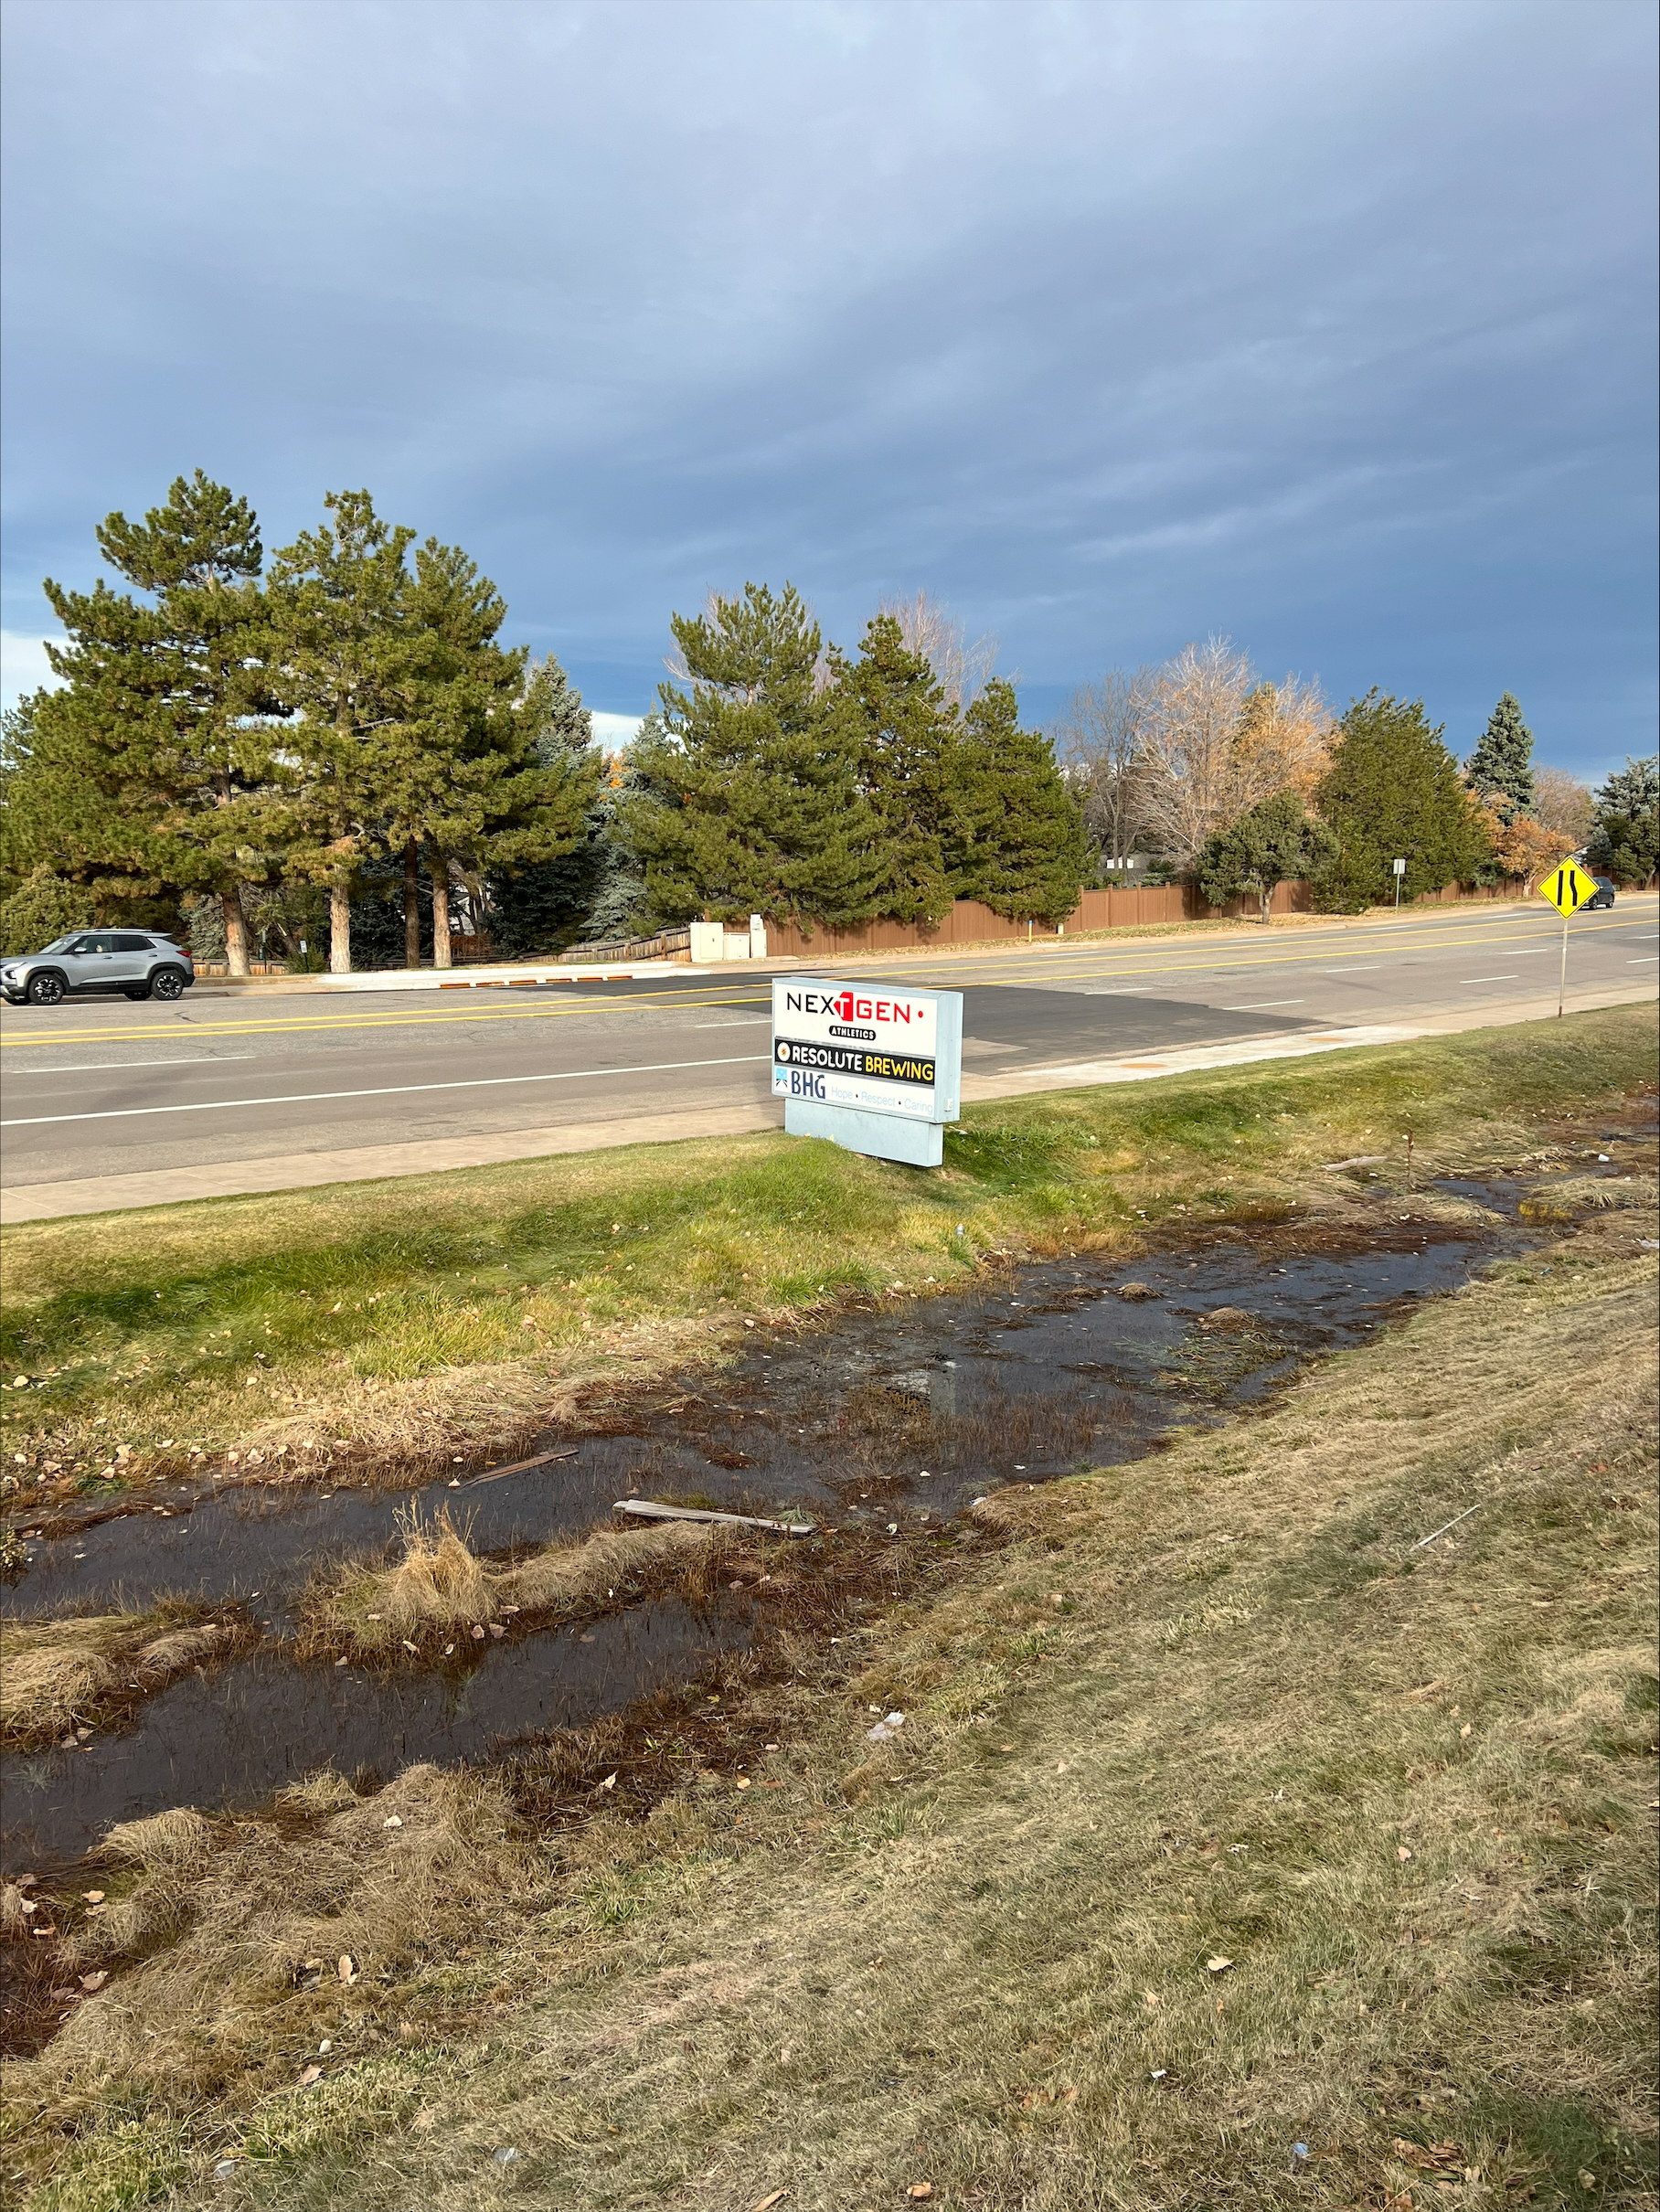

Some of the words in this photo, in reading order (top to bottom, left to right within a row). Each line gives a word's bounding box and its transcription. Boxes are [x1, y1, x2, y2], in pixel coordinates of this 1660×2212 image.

[831, 1026, 875, 1039] ATHLETICS
[792, 1046, 863, 1071] RESOLUTE
[865, 1056, 934, 1081] BREWING
[791, 1070, 826, 1100] BHG
[831, 1086, 853, 1101] Hope
[861, 1090, 896, 1108] Respect
[904, 1098, 933, 1115] Caring
